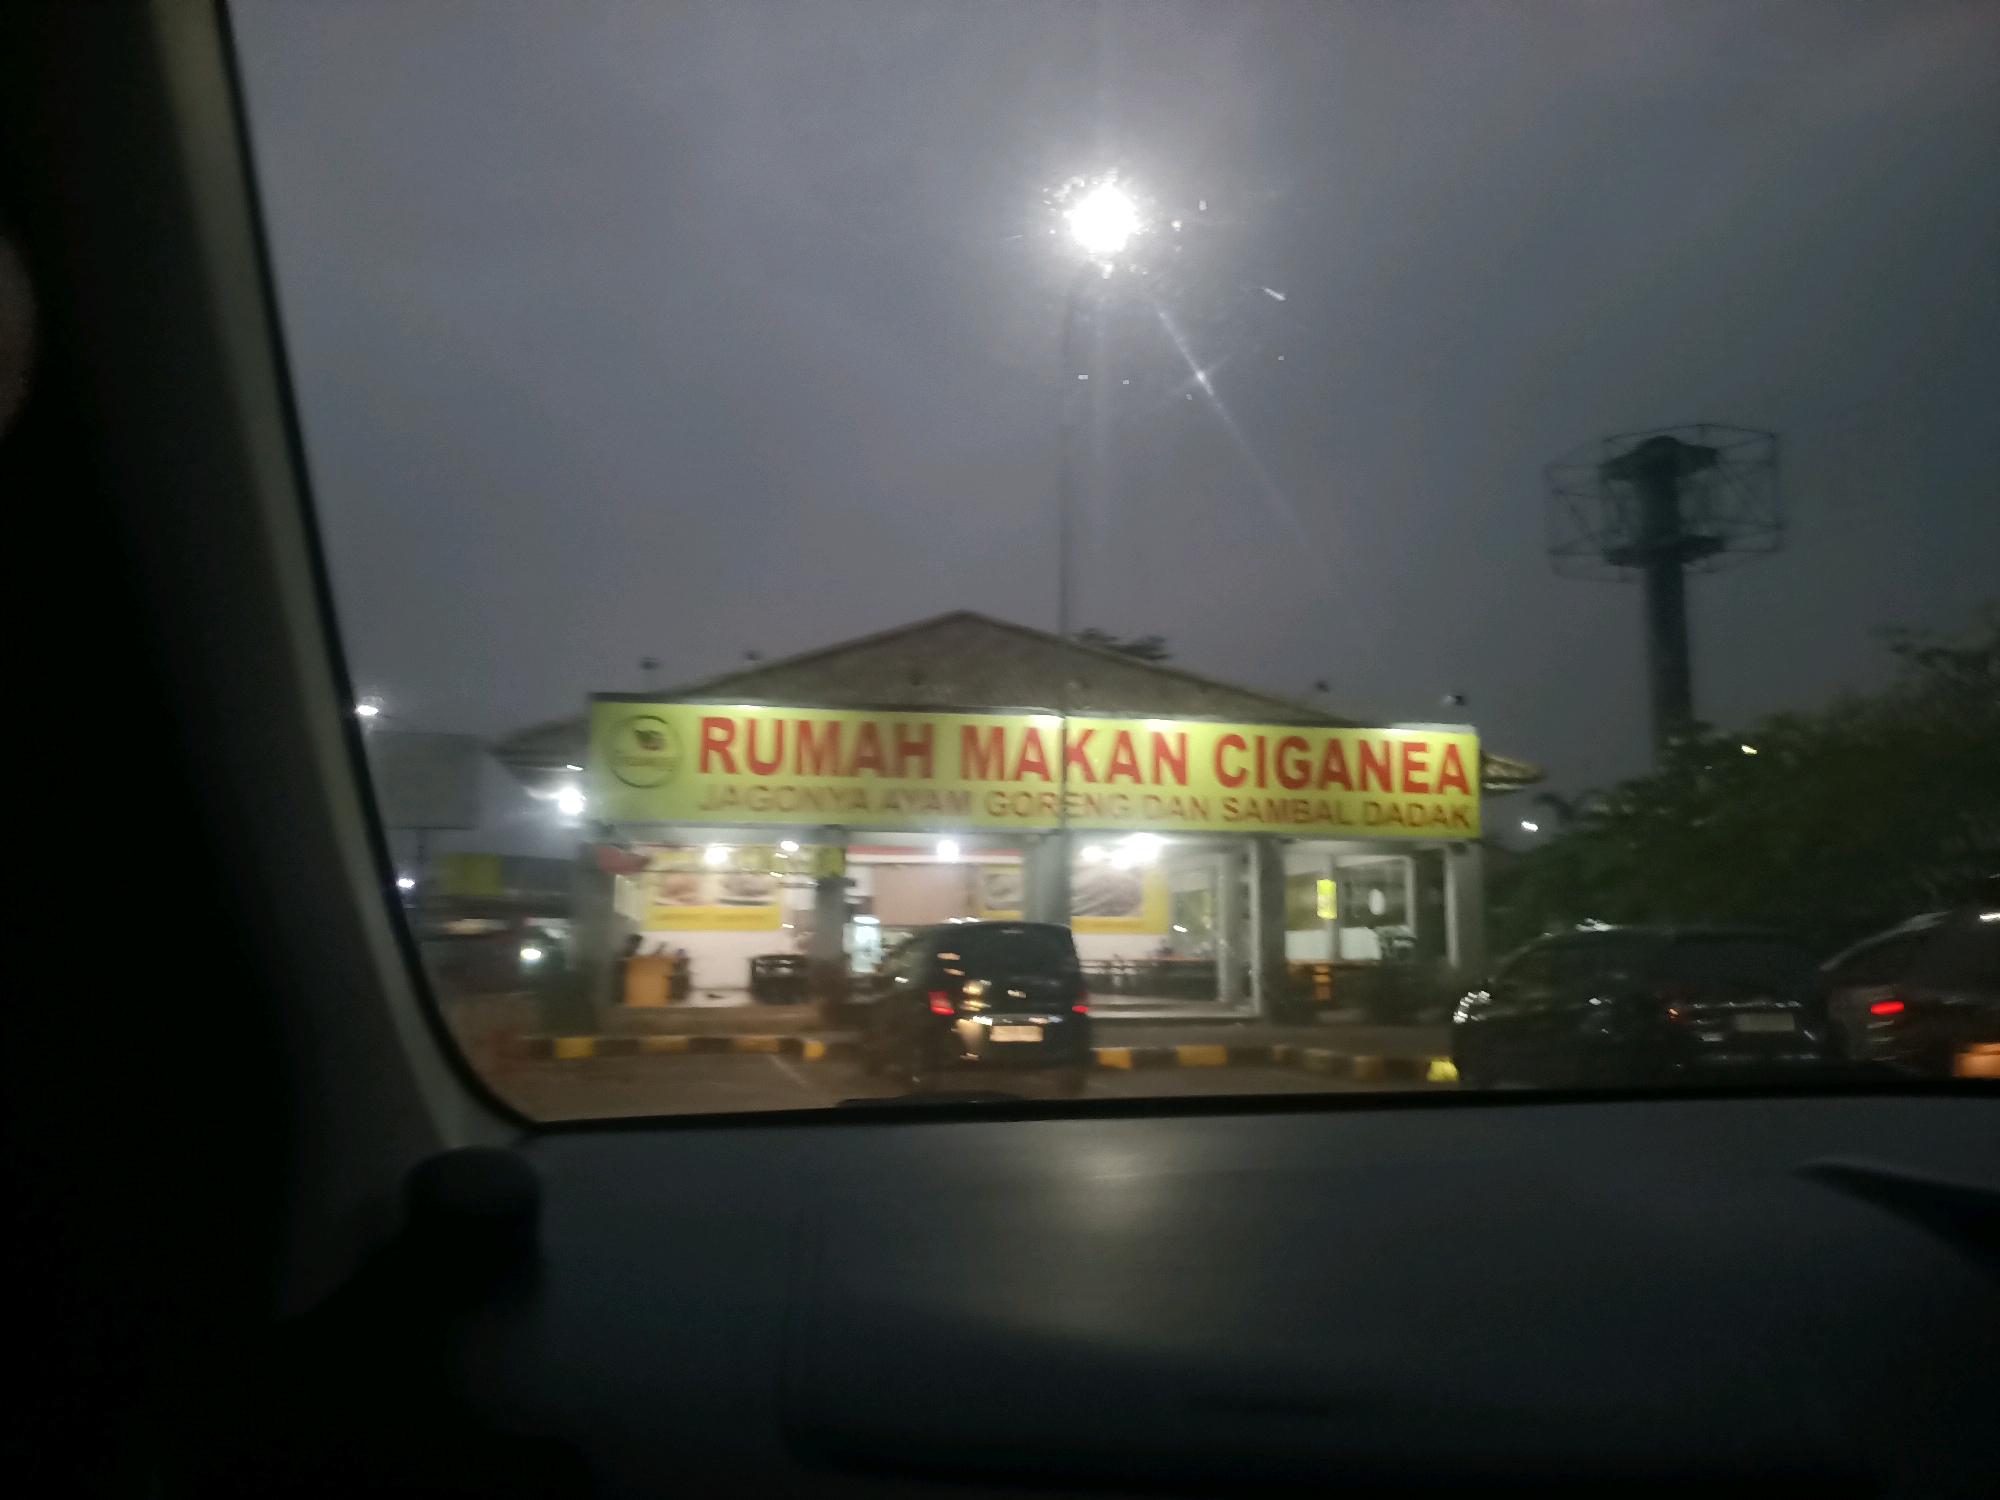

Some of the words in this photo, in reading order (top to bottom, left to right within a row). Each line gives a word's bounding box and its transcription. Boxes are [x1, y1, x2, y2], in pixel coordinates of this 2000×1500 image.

[699, 716, 935, 779] RUMAH
[959, 724, 1188, 785] MAKAN
[1213, 734, 1470, 795] CIGANEA
[1144, 794, 1208, 821] DAN
[1223, 797, 1353, 825] SAMBAL
[1365, 801, 1471, 829] DADAK
